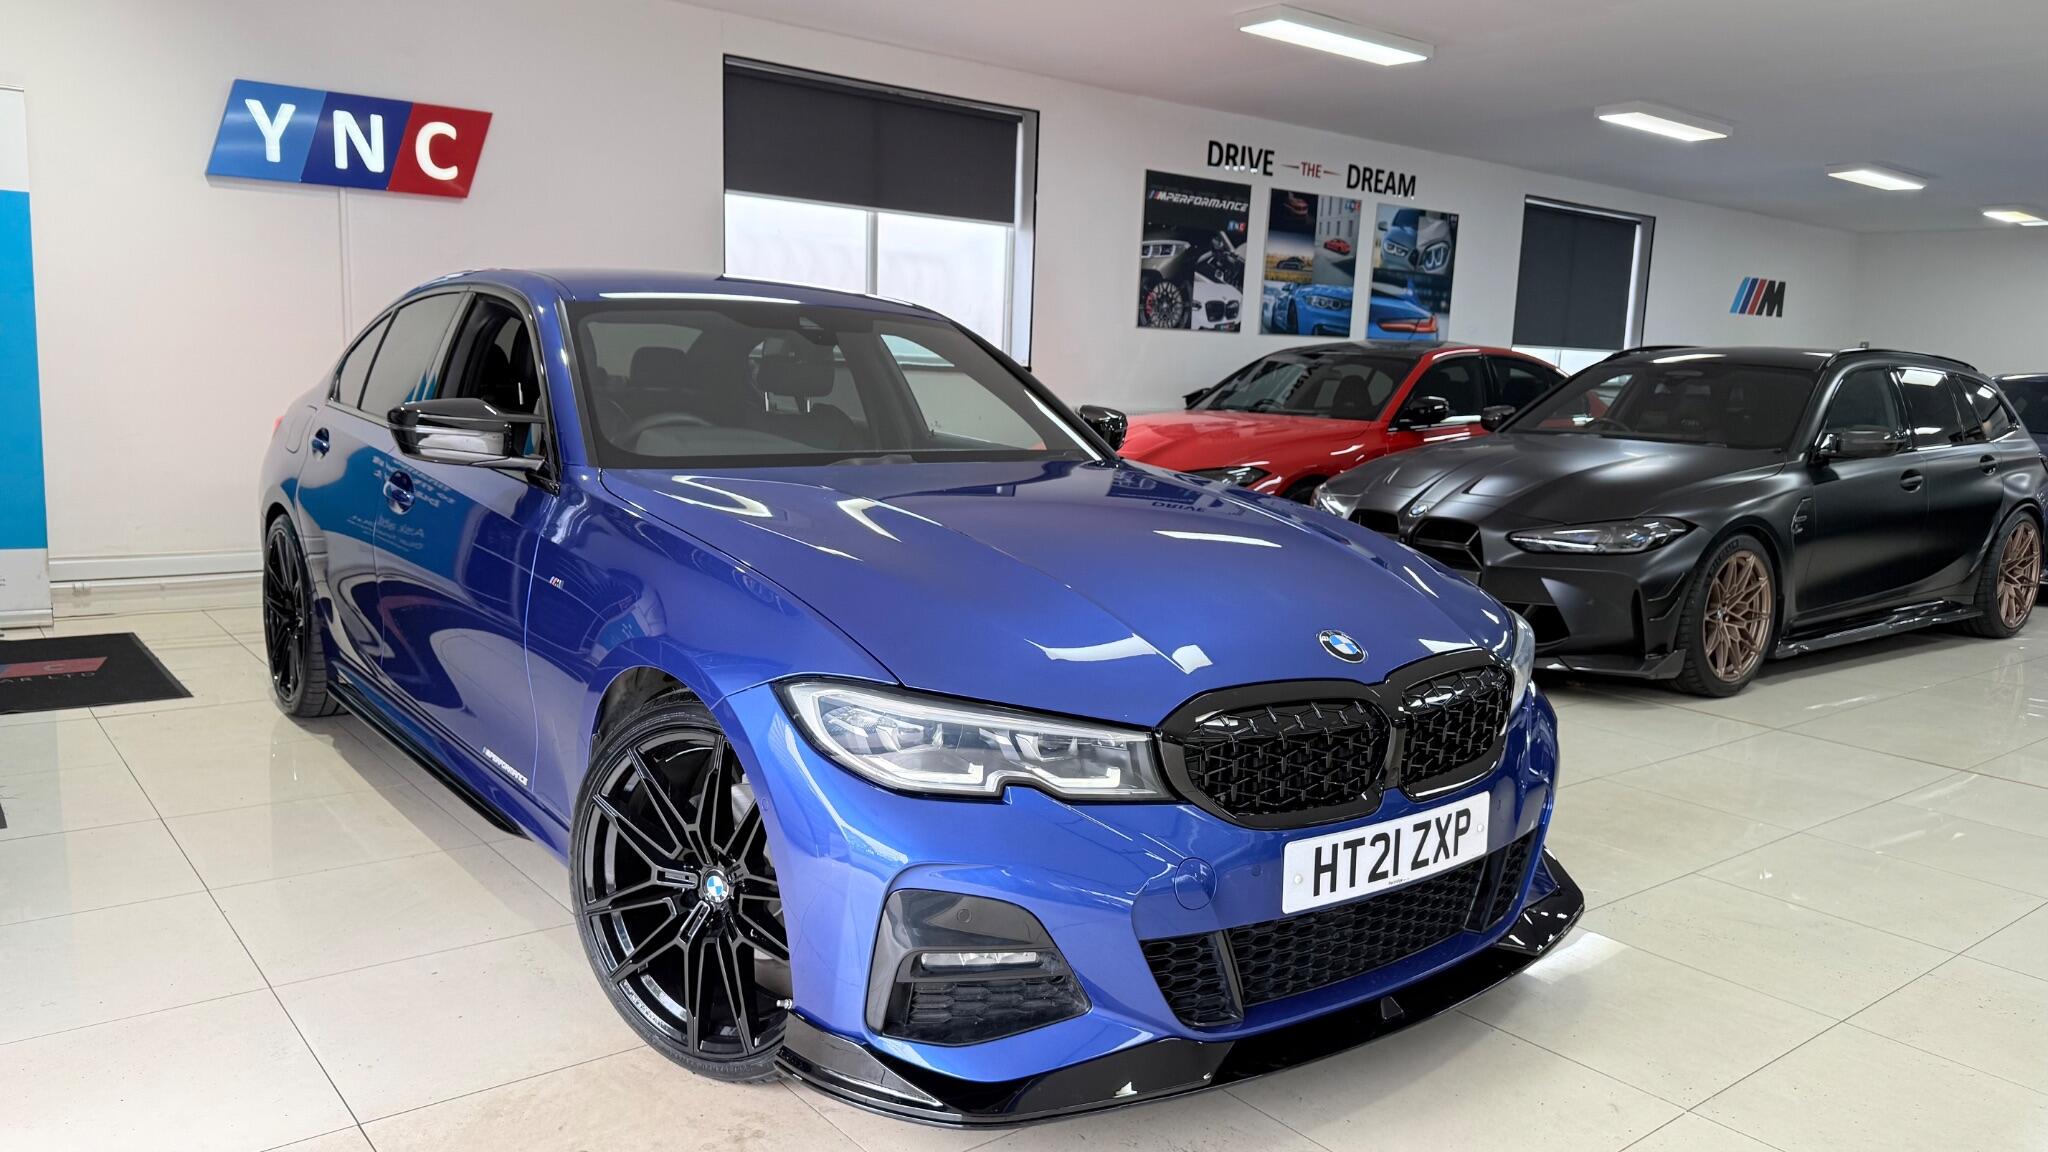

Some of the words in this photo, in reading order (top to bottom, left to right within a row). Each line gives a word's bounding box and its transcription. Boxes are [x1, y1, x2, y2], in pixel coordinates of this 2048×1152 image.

[245, 98, 459, 181] YNC
[1207, 140, 1275, 177] DRIVE
[1300, 161, 1322, 178] THE
[1346, 164, 1417, 197] DREAM
[1313, 828, 1400, 898] HT21
[1410, 807, 1472, 869] ZXP
